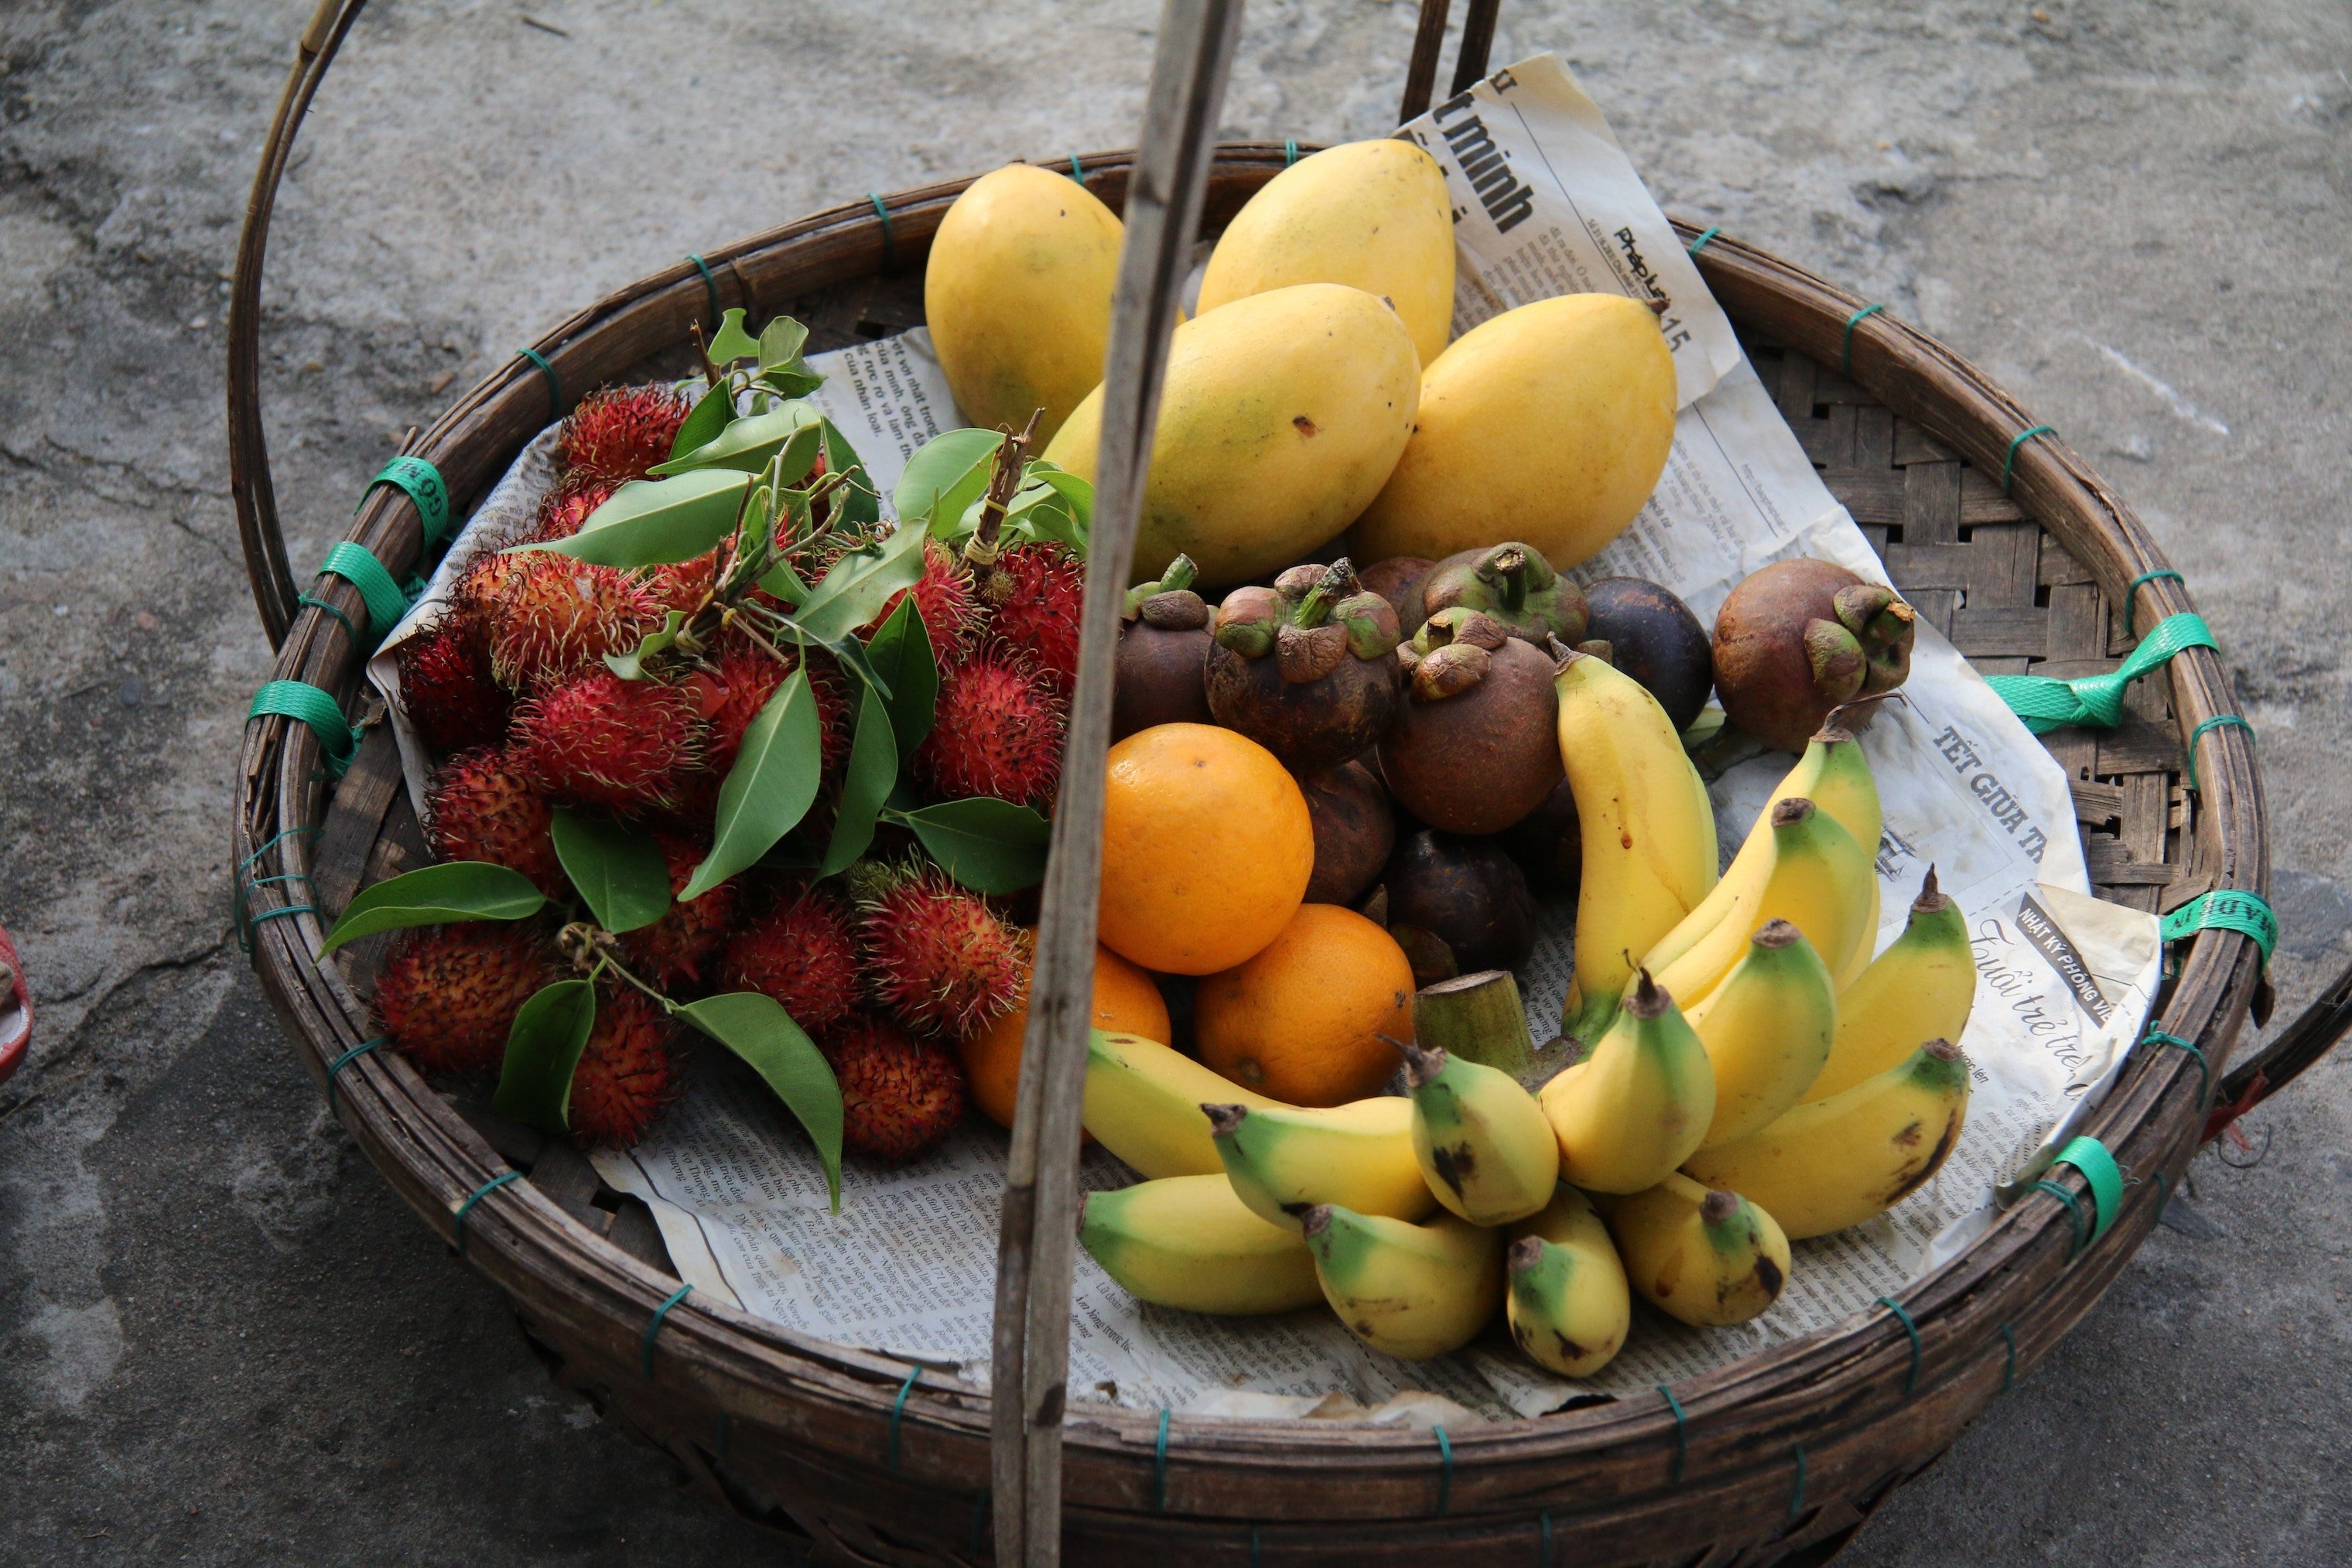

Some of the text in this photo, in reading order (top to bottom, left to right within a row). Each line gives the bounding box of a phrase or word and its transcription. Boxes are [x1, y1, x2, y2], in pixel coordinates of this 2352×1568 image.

[1443, 115, 1534, 234] minh
[1614, 227, 1648, 278] Pháp
[844, 353, 882, 437] của nhân loại.
[884, 370, 904, 402] mình,
[901, 405, 917, 429] ông
[907, 377, 926, 404] nhất
[887, 418, 904, 440] làm
[1933, 726, 1981, 774] TẾT
[1971, 774, 2027, 833] GIỮA
[2018, 904, 2051, 942] NHẬT
[2043, 932, 2067, 954] KÝ
[2058, 950, 2101, 1002] PHÓNG
[1971, 918, 2032, 997] Tuổi
[2012, 995, 2067, 1036] trẻ
[1971, 1068, 1989, 1084] lên
[689, 1166, 710, 1197] Thượng
[719, 1165, 734, 1186] triệu
[746, 1159, 765, 1180] Minh
[759, 1181, 775, 1201] luôn
[773, 1178, 788, 1200] biển,
[937, 1213, 960, 1241] Thượng
[1085, 1308, 1106, 1329] lòng
